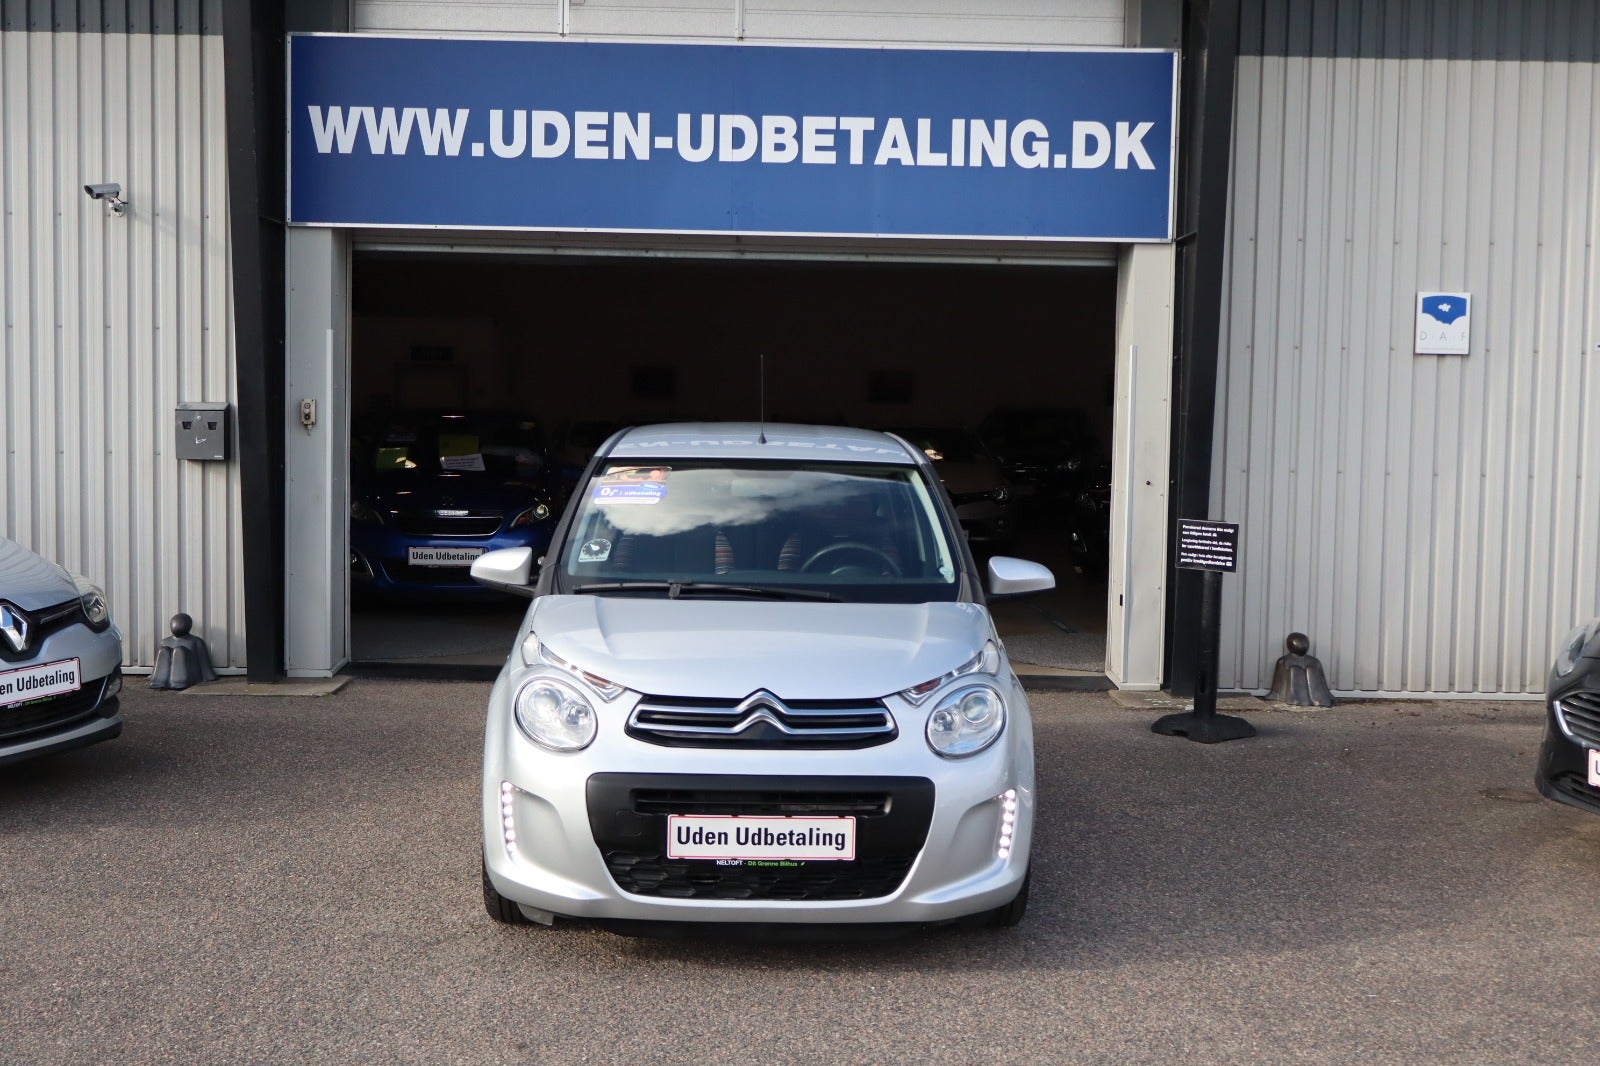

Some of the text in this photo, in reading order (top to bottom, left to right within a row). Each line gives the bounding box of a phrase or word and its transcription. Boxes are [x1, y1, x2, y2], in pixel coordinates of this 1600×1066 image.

[307, 105, 1156, 170] WWW.UDEN-UDBETALING.DK
[412, 552, 434, 561] Uden
[17, 670, 75, 691] Udbetaling
[677, 826, 846, 851] Uden Udbetaling
